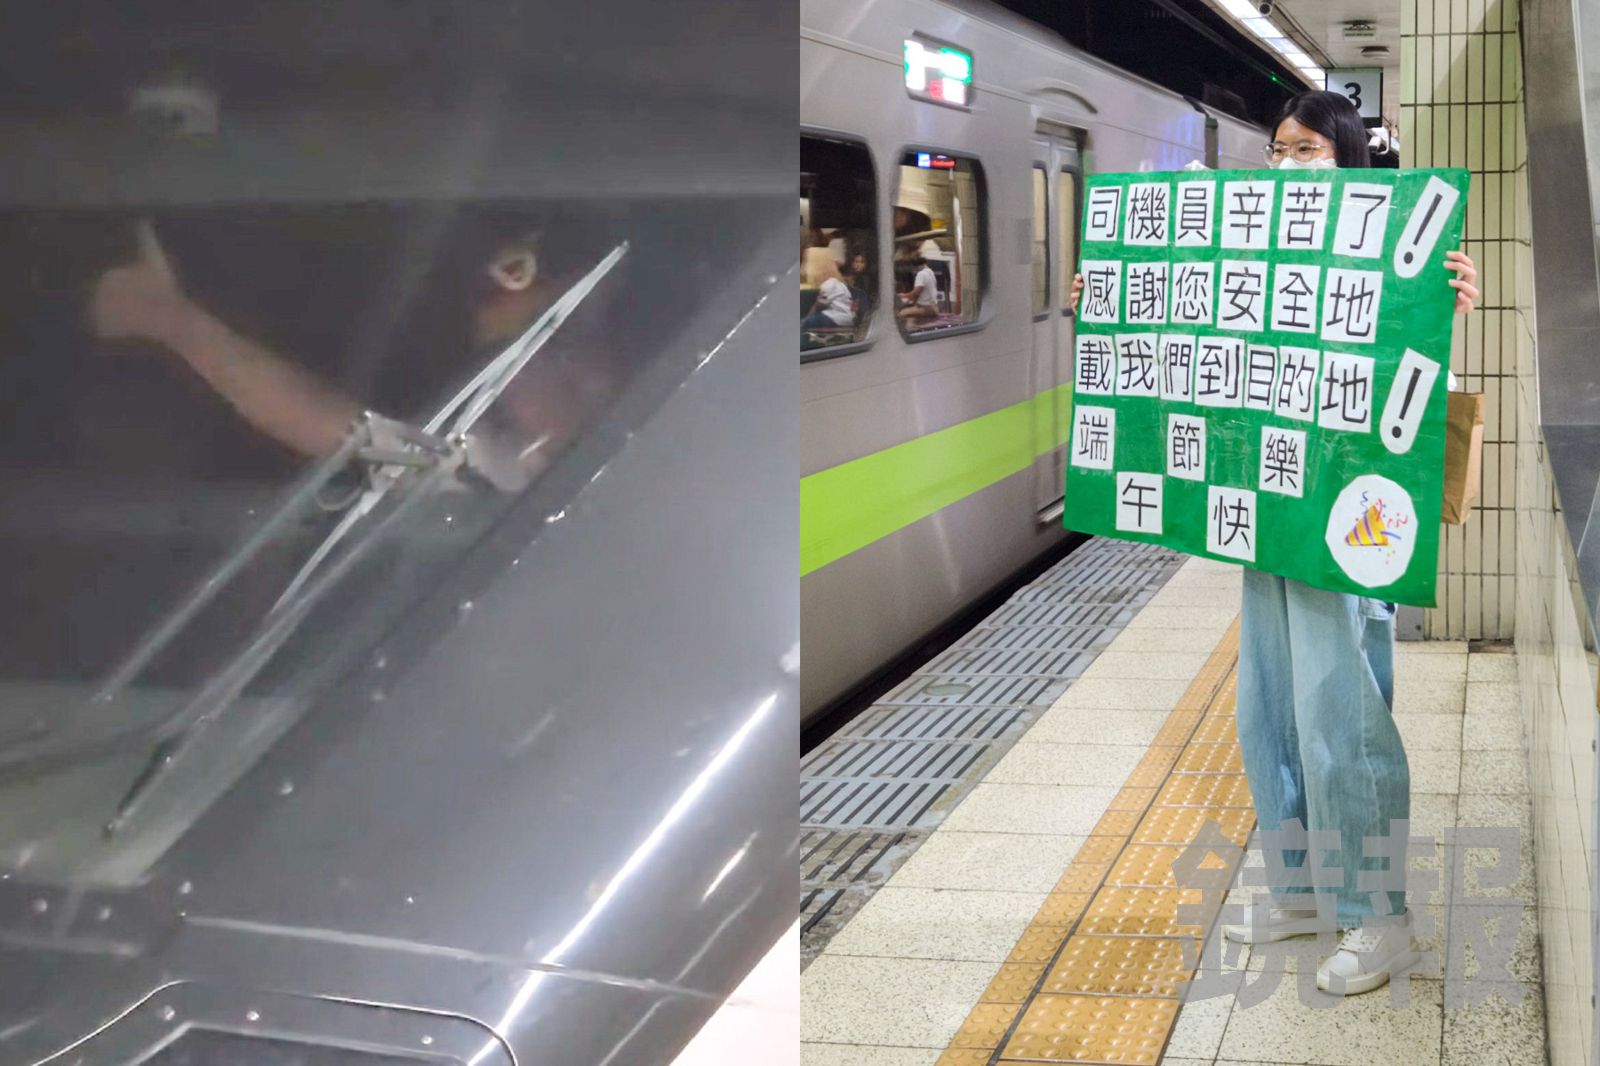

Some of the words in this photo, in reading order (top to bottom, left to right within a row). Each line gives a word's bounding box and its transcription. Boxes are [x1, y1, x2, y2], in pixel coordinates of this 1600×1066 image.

[1344, 82, 1362, 110] 3
[1090, 183, 1442, 265] 司機員辛苦了!
[1084, 266, 1373, 337] 感謝您安全地
[1079, 338, 1422, 439] 載我們到目的地!
